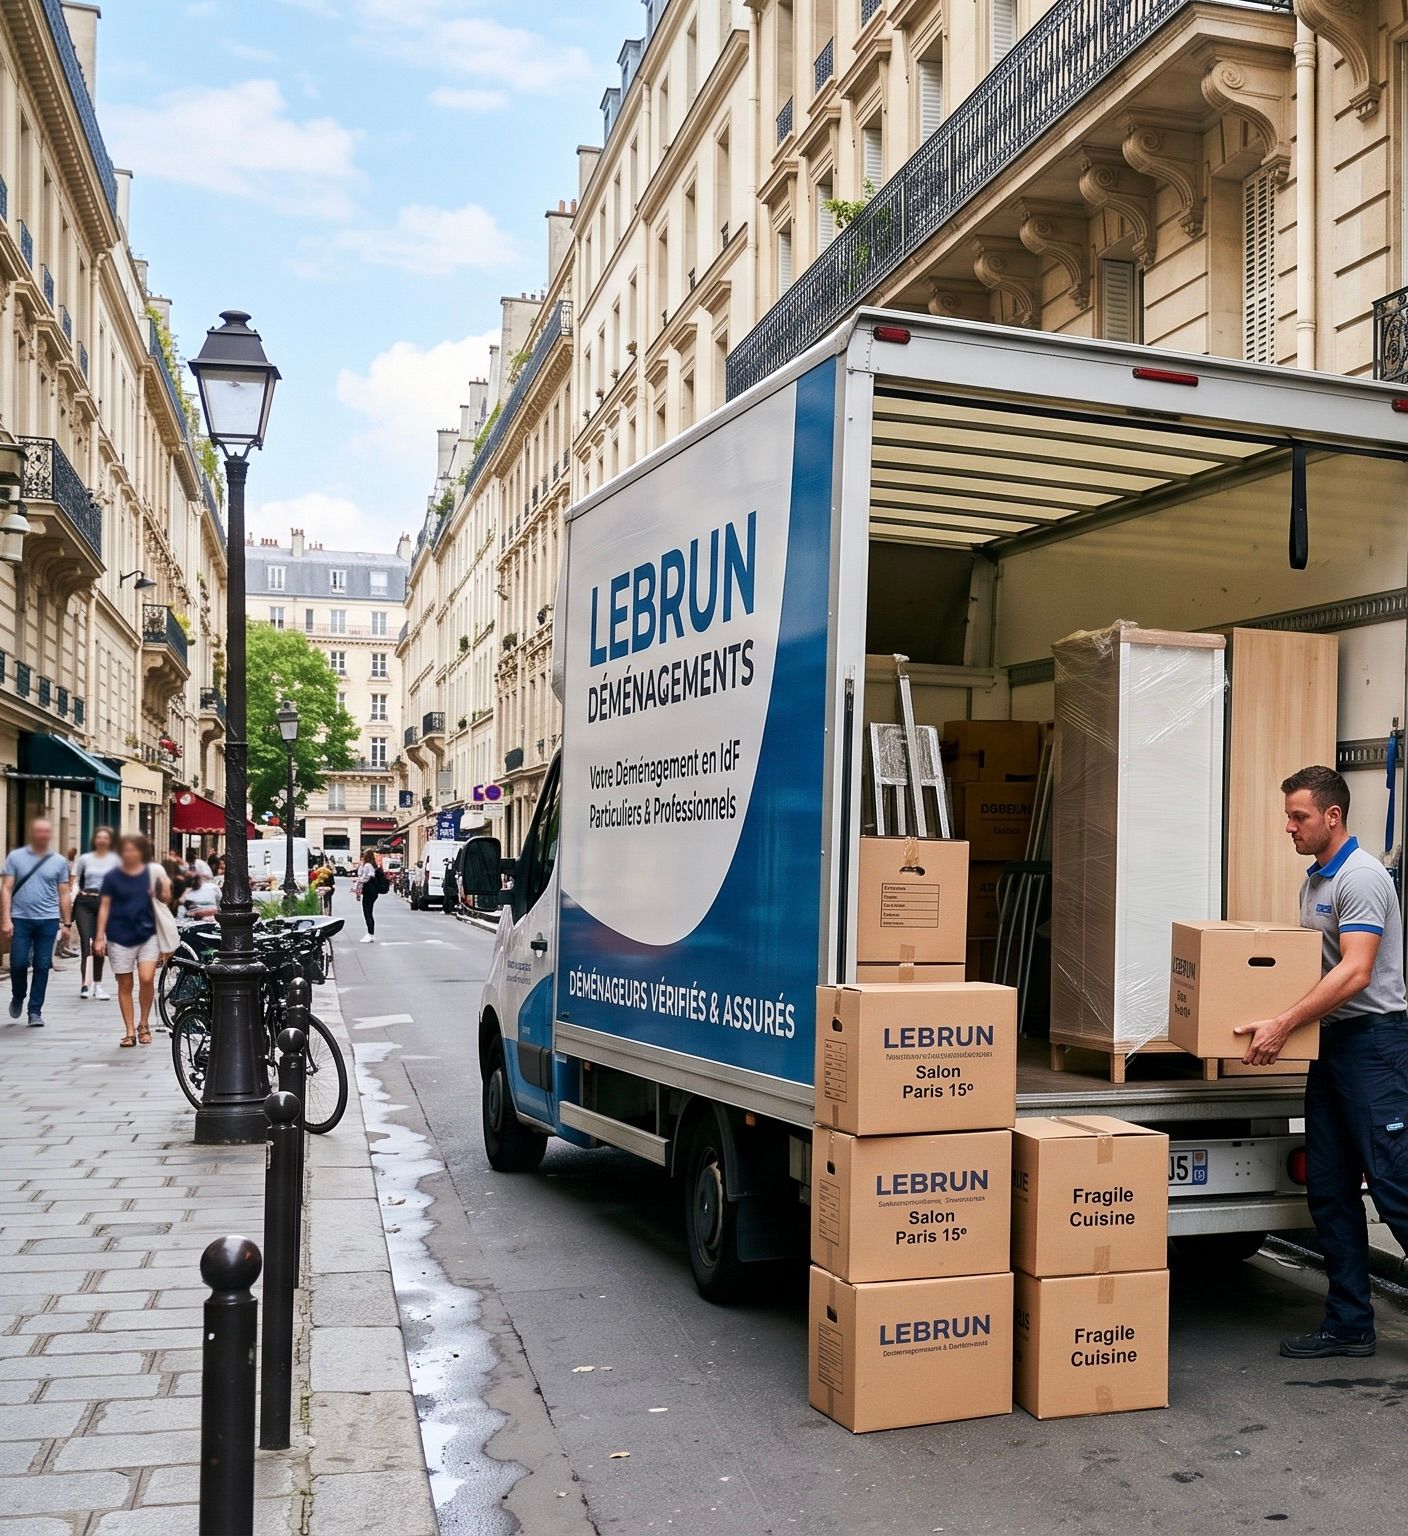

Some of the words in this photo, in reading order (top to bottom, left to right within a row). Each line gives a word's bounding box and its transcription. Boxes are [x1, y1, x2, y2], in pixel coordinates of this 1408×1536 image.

[589, 510, 757, 667] LEBRUN
[588, 639, 754, 723] DÉMÉNAGEMENTS
[590, 765, 614, 789] Votre
[616, 749, 699, 787] Déménagement
[702, 750, 717, 774] en
[720, 739, 741, 772] IdF
[590, 798, 642, 828] Particuliers
[644, 798, 651, 825] &
[654, 787, 736, 824] Professionnels
[569, 964, 648, 1010] DÉMÉNAGEURS
[650, 976, 706, 1022] VÉRIFIÉS
[709, 991, 719, 1025] &
[722, 992, 795, 1039] ASSURÉS
[884, 1025, 994, 1049] LEBRUN
[916, 1065, 961, 1079] Salon
[903, 1084, 943, 1098] Paris
[876, 1170, 988, 1196] LEBRUN
[1073, 1187, 1134, 1206] Fragile
[909, 1210, 955, 1224] Salon
[1069, 1211, 1135, 1227] Cuisine
[896, 1230, 936, 1245] Paris
[880, 1314, 991, 1345] LEBRUN
[1074, 1325, 1135, 1345] Fragile
[1071, 1349, 1137, 1367] Cuisine
